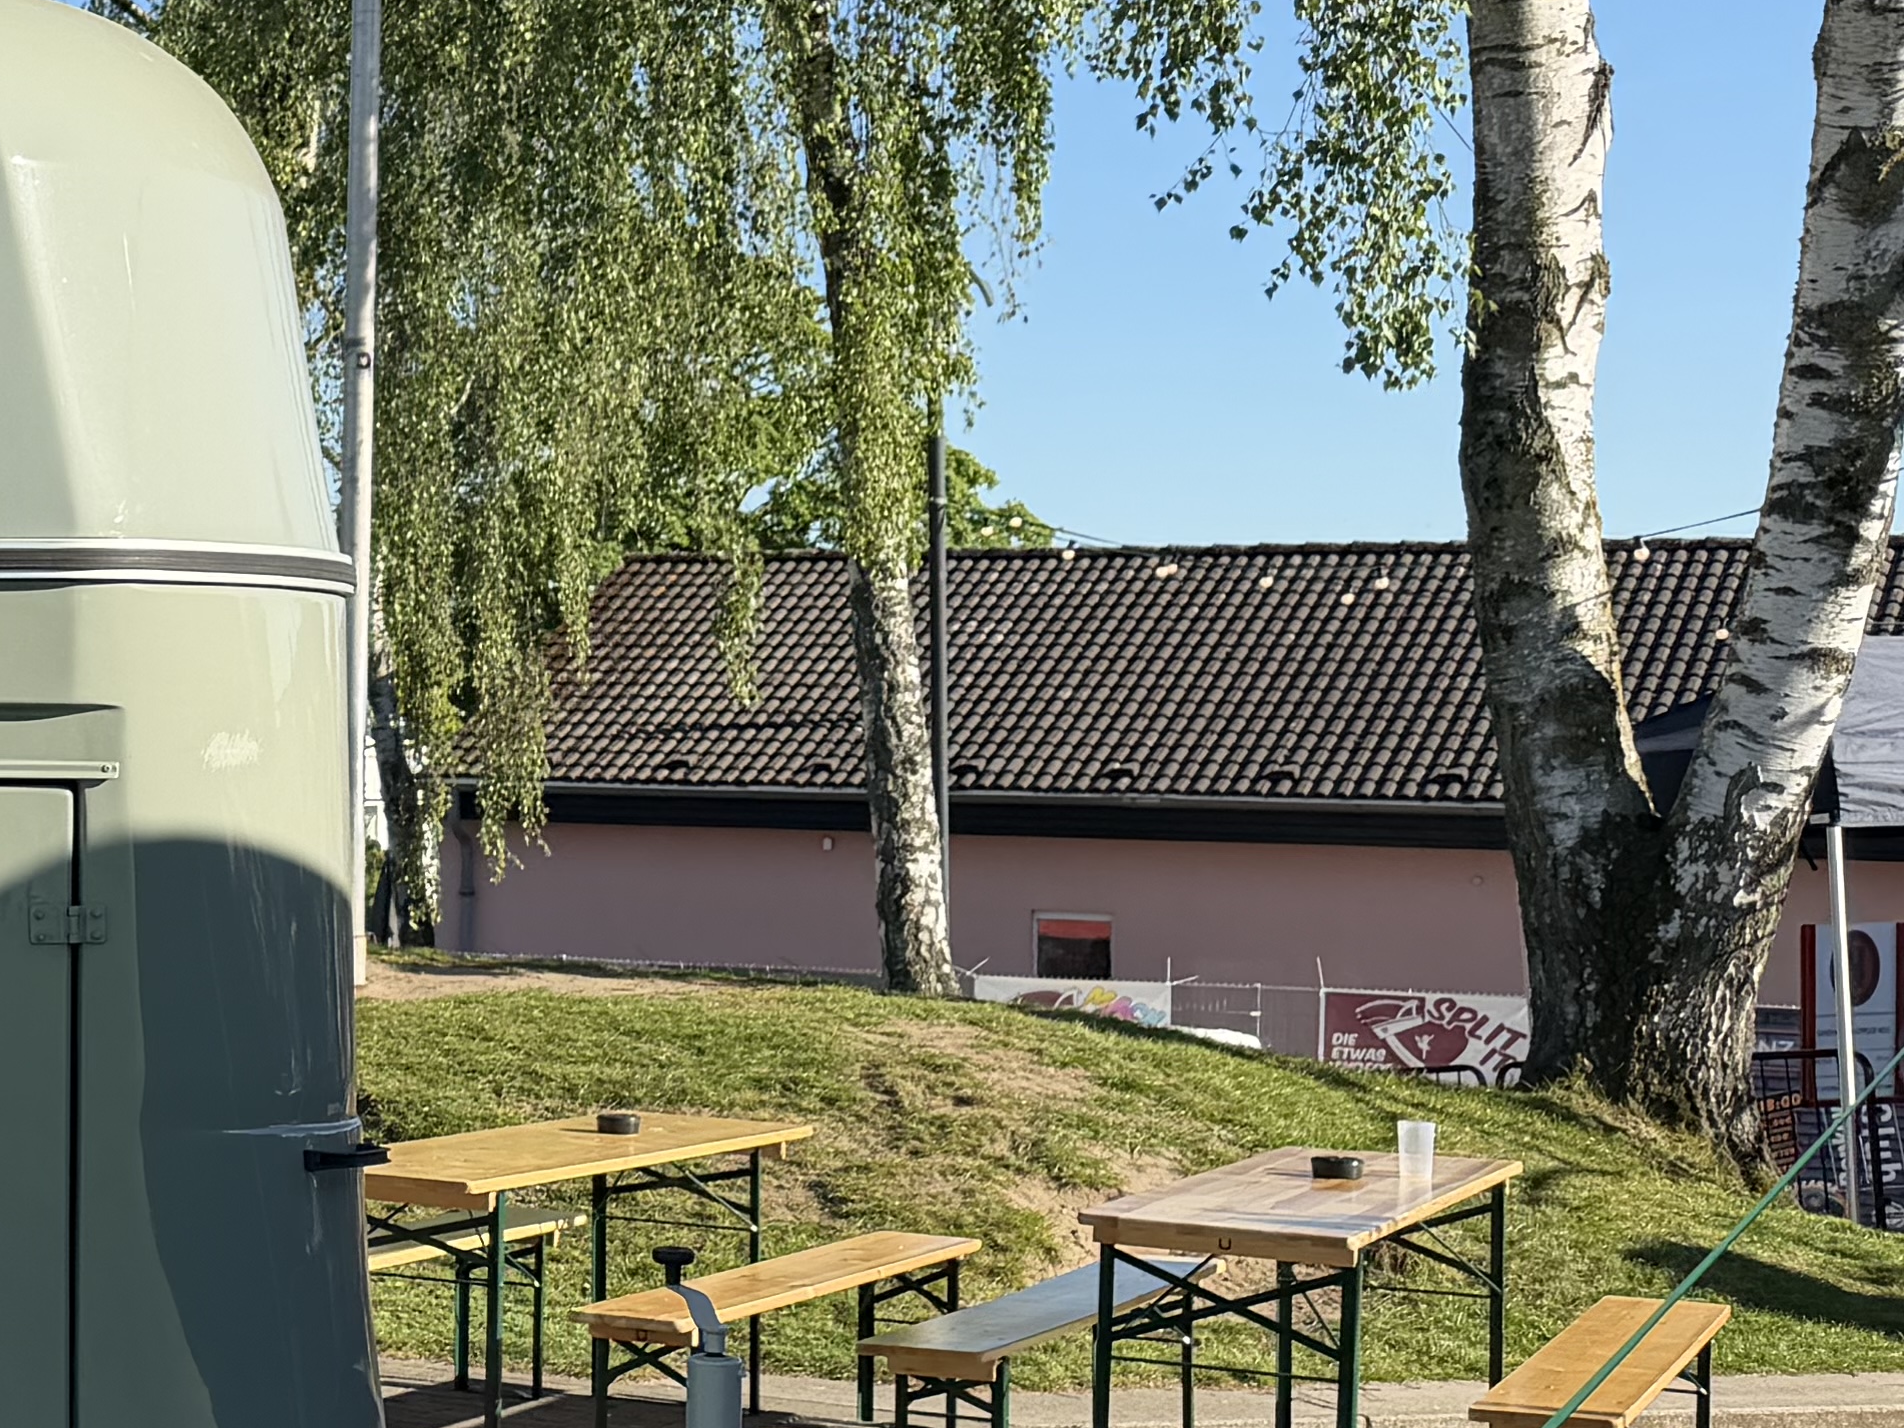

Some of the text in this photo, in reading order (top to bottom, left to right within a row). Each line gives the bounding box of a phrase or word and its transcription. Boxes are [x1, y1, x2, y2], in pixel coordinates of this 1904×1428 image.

[1427, 998, 1527, 1052] SPLIT
[1332, 1032, 1358, 1046] DIE
[1331, 1047, 1386, 1062] ETWAS
